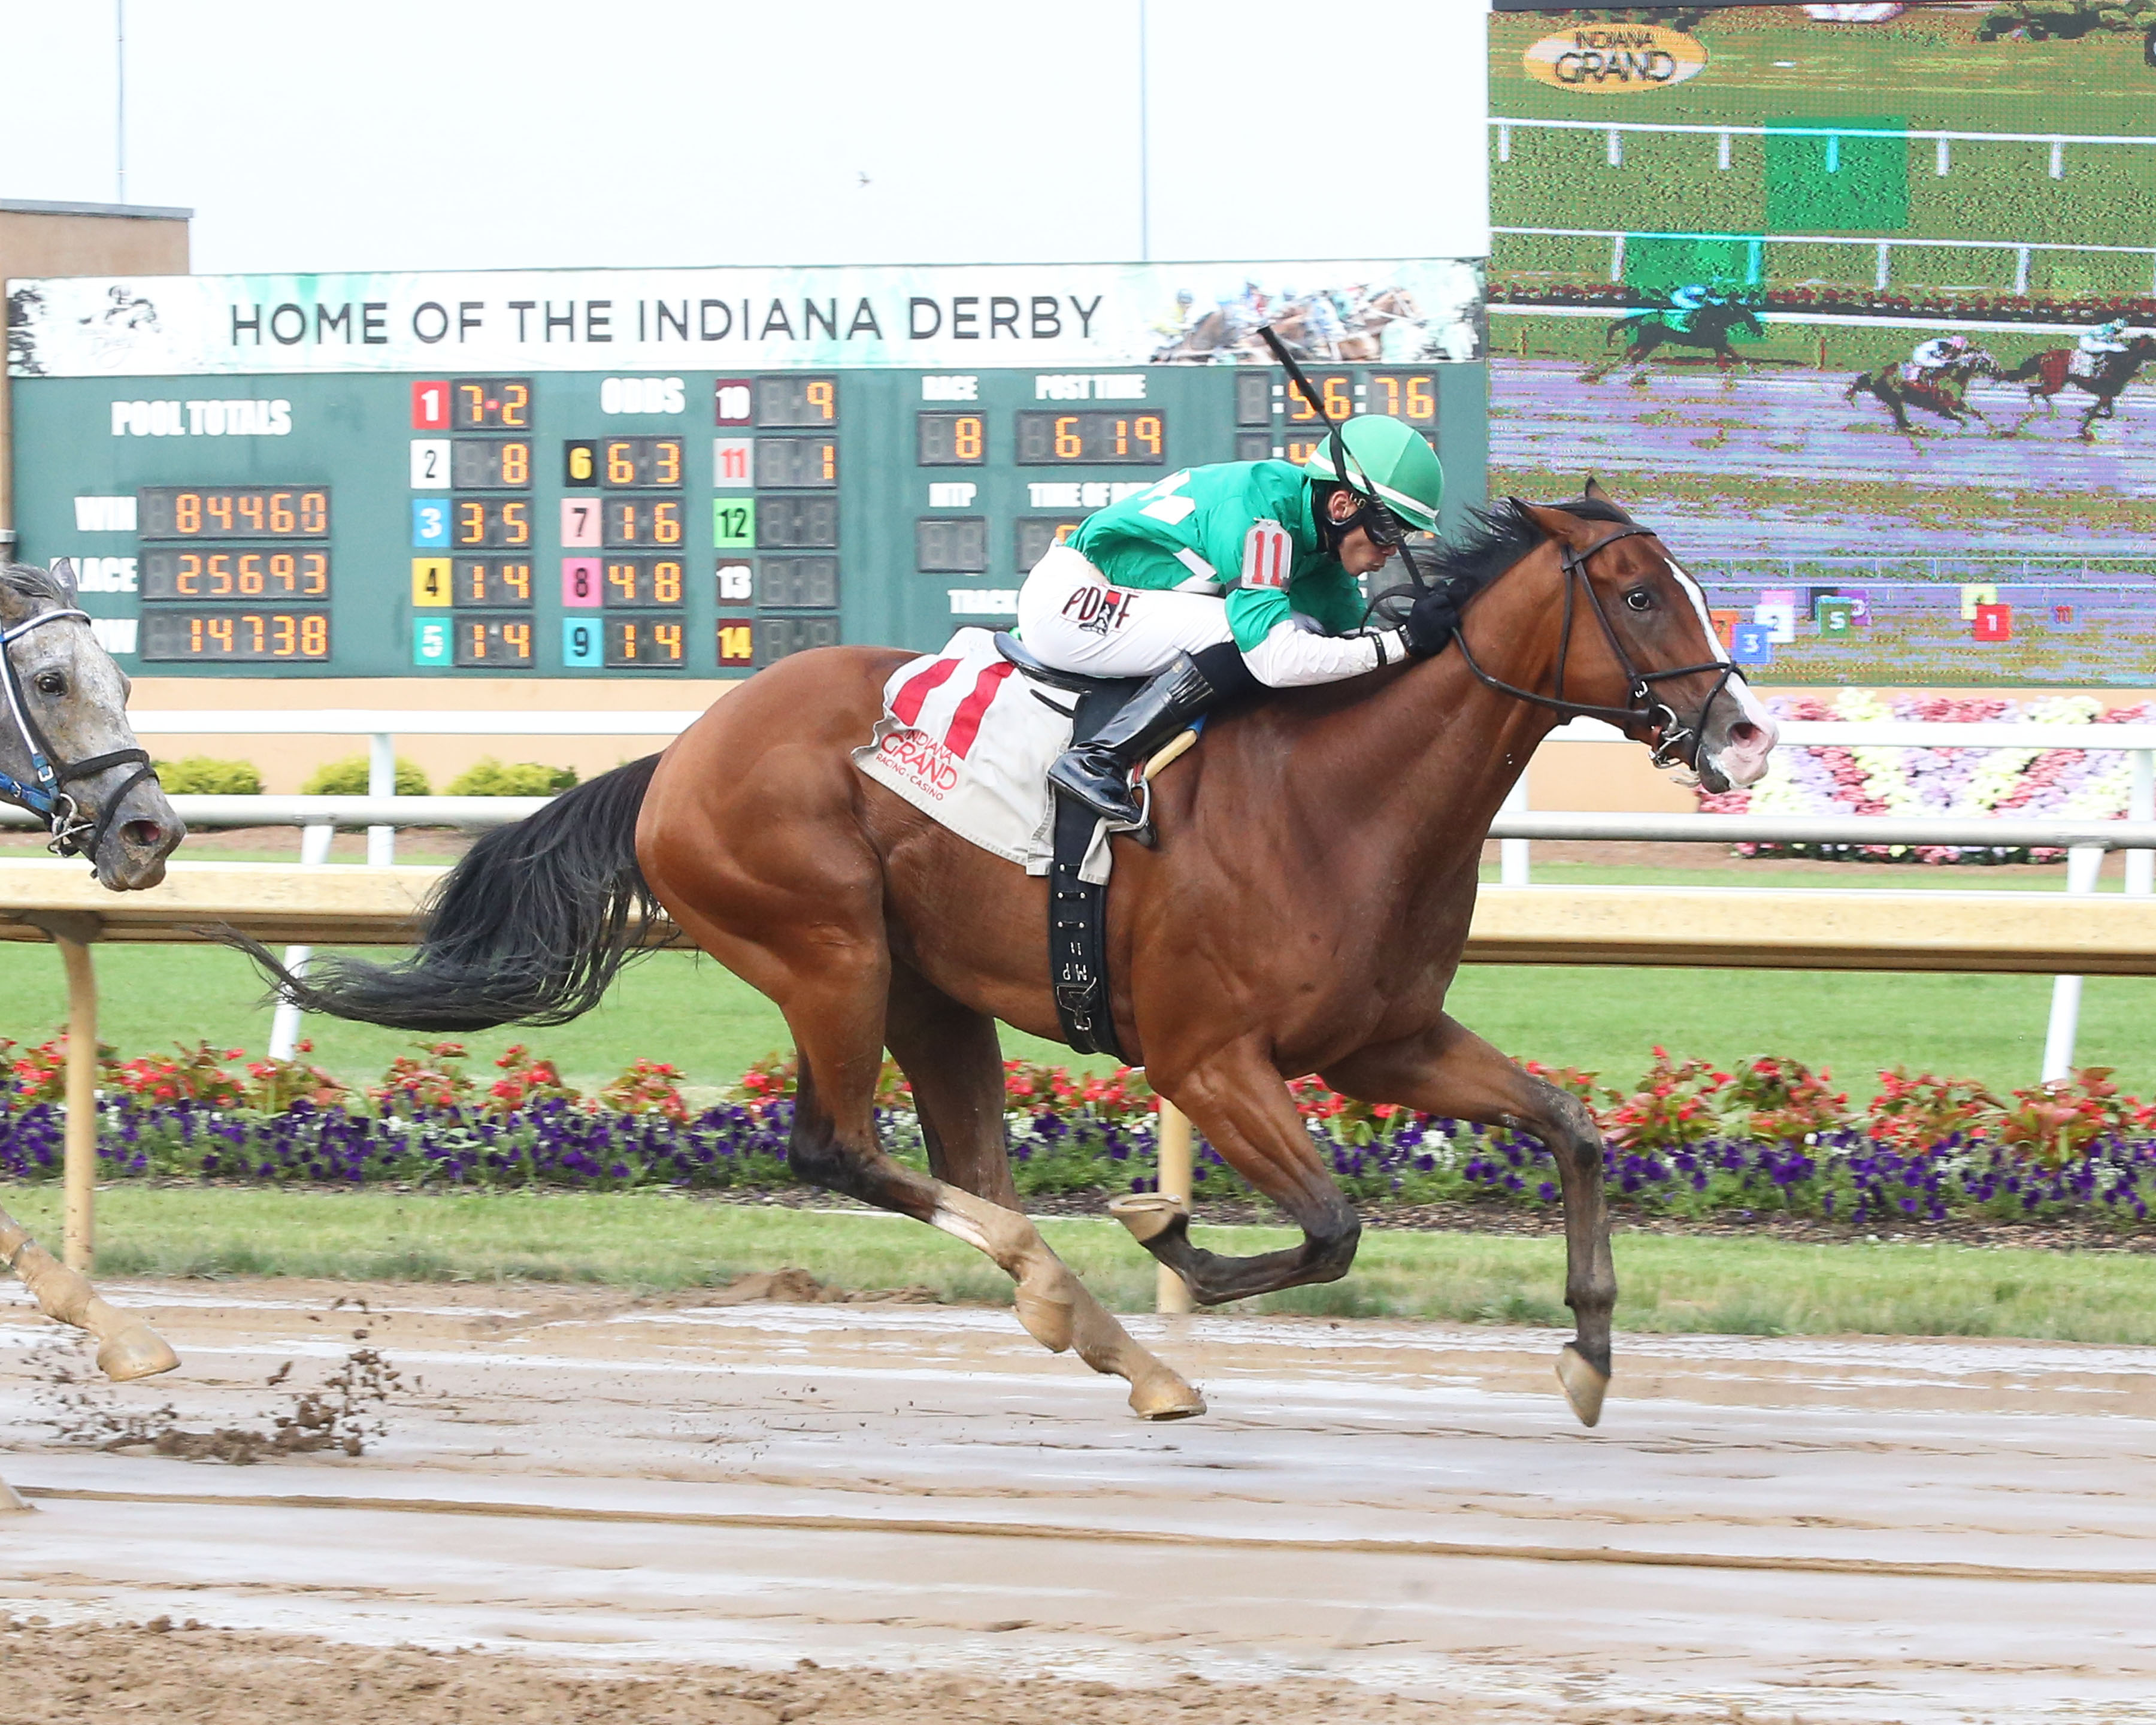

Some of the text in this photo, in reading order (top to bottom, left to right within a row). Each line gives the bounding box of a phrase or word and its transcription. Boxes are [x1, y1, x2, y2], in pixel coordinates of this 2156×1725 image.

[1555, 51, 1675, 83] GRAND
[232, 295, 1103, 346] HOME OF THE INDIANA DERBY
[601, 377, 685, 414] ODDS
[716, 386, 750, 419] 10
[807, 382, 834, 419] 9
[1035, 374, 1146, 400] POST TIME
[111, 400, 292, 436] POOL TOTALS
[421, 389, 439, 421] 1
[955, 417, 982, 459] 8
[425, 450, 437, 479] 2
[502, 443, 528, 483] 8
[570, 447, 592, 480] 6
[720, 448, 747, 478] 11
[822, 445, 834, 479] 1
[1028, 483, 1081, 507] TIME
[1082, 483, 1110, 507] OF
[177, 493, 326, 533] 84460
[420, 508, 443, 538] 3
[573, 508, 588, 537] 7
[717, 508, 747, 538] 12
[177, 554, 326, 594] 25693
[1252, 531, 1282, 586] 11
[425, 568, 438, 597] 4
[576, 568, 588, 598] 8
[716, 566, 752, 599] 13
[1829, 611, 1846, 630] 5
[1986, 613, 1998, 631] 1
[2055, 606, 2073, 624] 11
[191, 615, 327, 656] 14738
[422, 625, 443, 658] 5
[573, 627, 589, 658] 9
[717, 627, 753, 658] 14
[1742, 633, 1759, 653] 3
[881, 732, 958, 791] GRAND
[904, 729, 953, 765] INDIANA
[875, 752, 944, 801] RACING CASINO
